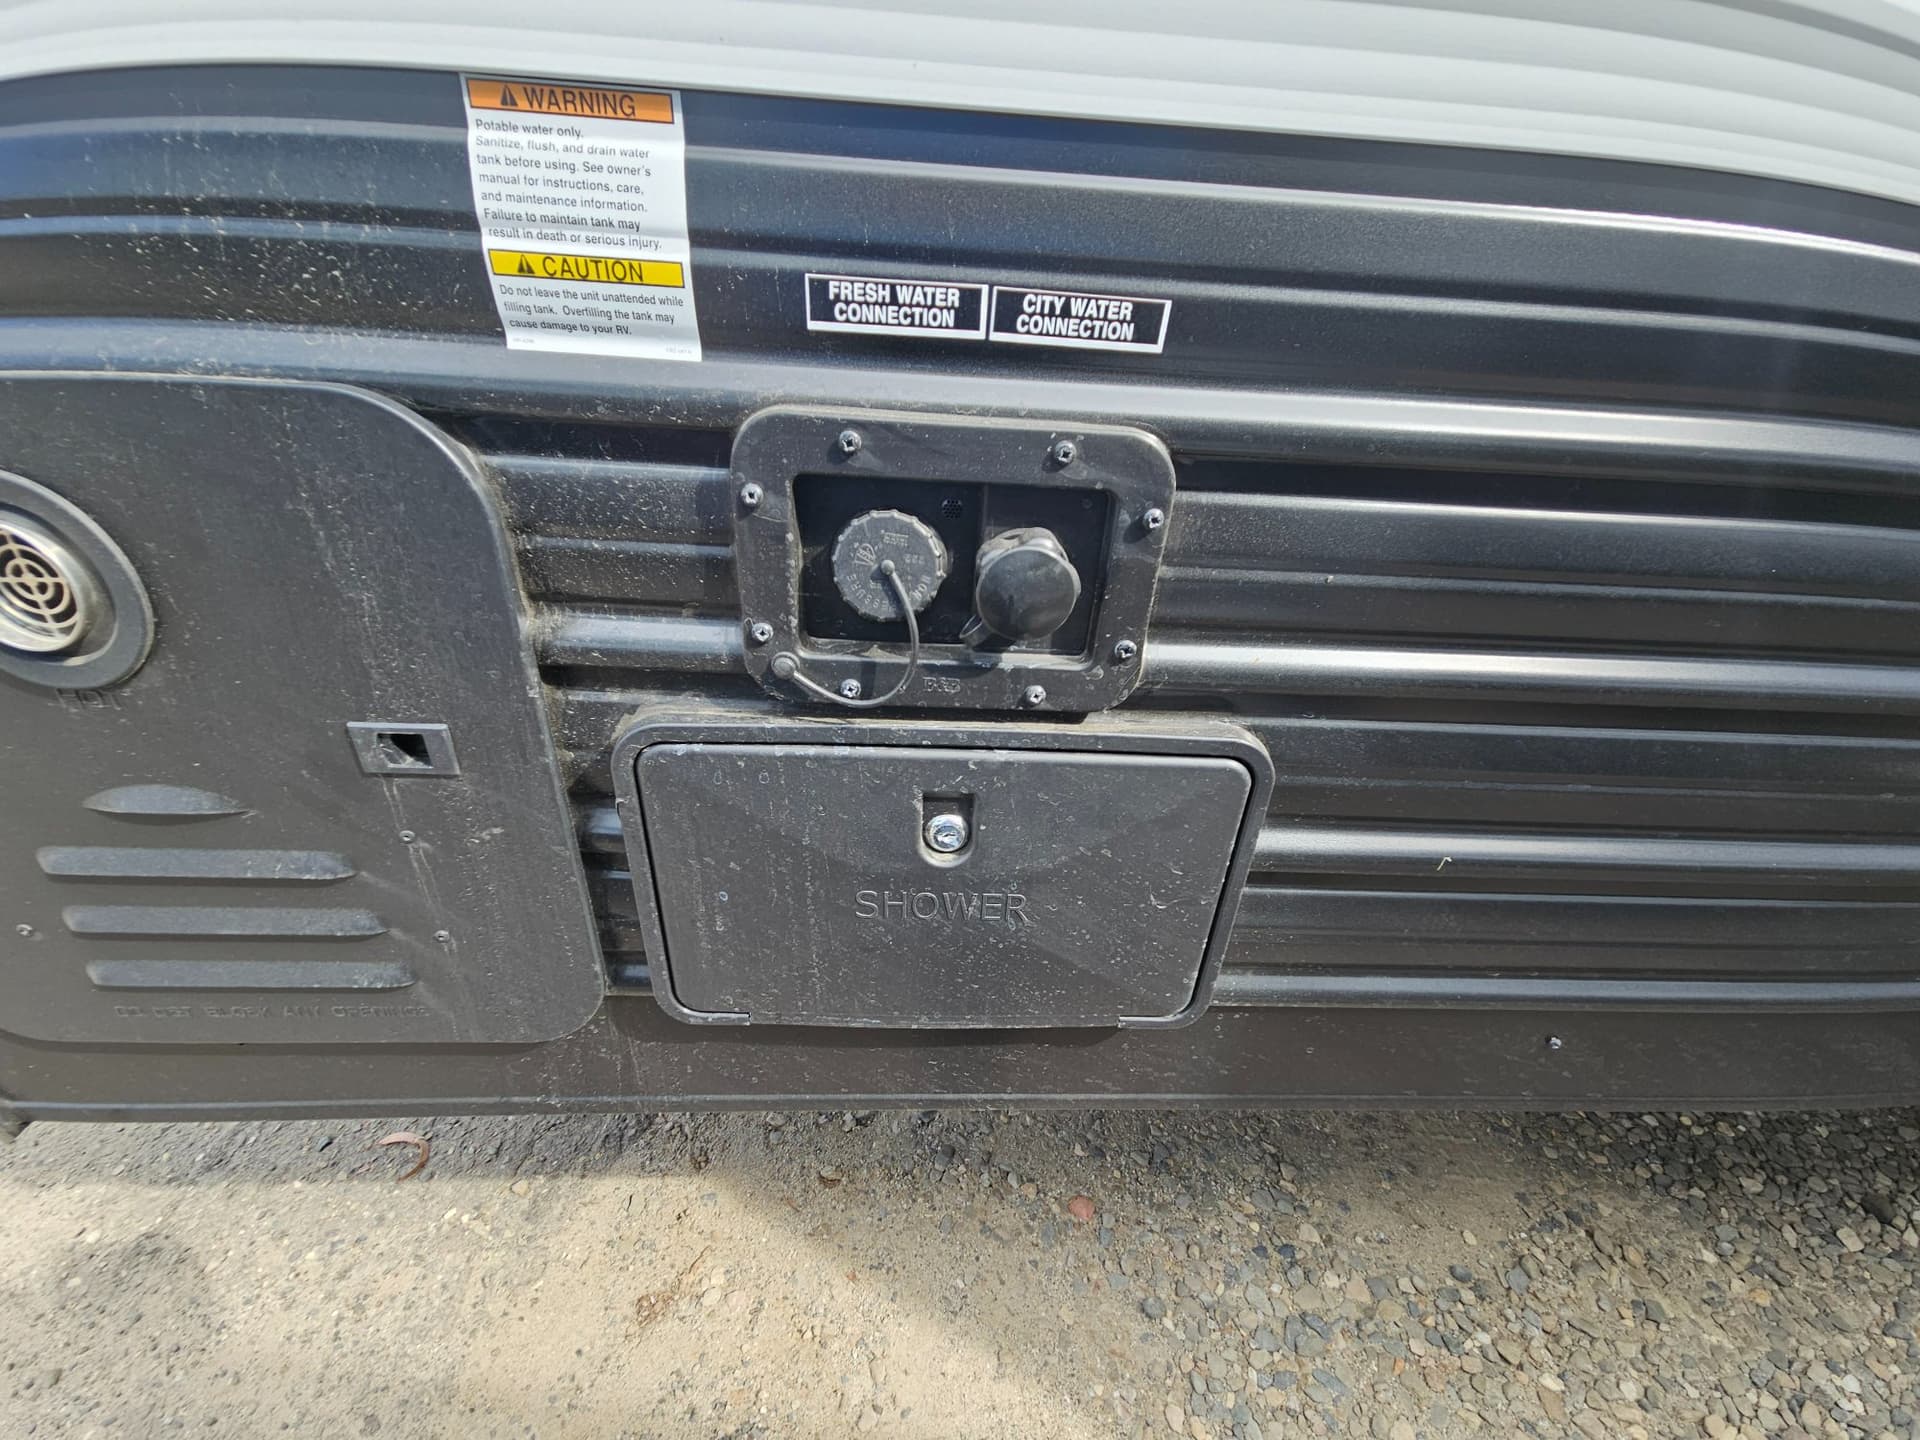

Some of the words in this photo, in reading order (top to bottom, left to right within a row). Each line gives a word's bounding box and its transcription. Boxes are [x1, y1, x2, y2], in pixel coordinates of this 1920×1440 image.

[523, 86, 636, 117] WARNING
[475, 119, 519, 133] Potable
[522, 123, 553, 135] water
[557, 126, 583, 140] only.
[475, 136, 524, 150] Sanitize,
[527, 140, 559, 153] flush,
[562, 143, 583, 154] and
[587, 144, 616, 156] drain
[620, 148, 649, 159] water
[477, 154, 501, 165] tank
[505, 156, 541, 169] before
[545, 160, 579, 173] using.
[583, 161, 603, 173] See
[607, 164, 651, 177] owner's
[479, 172, 520, 185] manual
[524, 175, 539, 186] for
[543, 176, 614, 193] instructions,
[616, 183, 644, 195] care,
[481, 191, 501, 202] and
[505, 192, 577, 206] maintenance
[580, 197, 648, 212] information.
[483, 208, 522, 221] Failure
[526, 211, 537, 222] to
[540, 213, 588, 226] maintain
[590, 217, 615, 228] tank
[618, 221, 640, 232] may
[488, 228, 520, 238] result
[523, 229, 534, 239] in
[536, 230, 566, 242] death
[570, 234, 581, 243] or
[585, 233, 625, 246] serious
[628, 235, 662, 250] injury.
[542, 256, 643, 282] CAUTION
[499, 284, 514, 295] Do
[516, 286, 533, 297] not
[535, 287, 560, 299] leave
[562, 289, 578, 300] the
[581, 290, 600, 302] unit
[602, 292, 656, 305] unattended
[658, 295, 684, 307] while
[829, 281, 890, 304] FRESH
[896, 285, 960, 308] WATER
[503, 302, 531, 315] filling
[533, 304, 557, 315] tank.
[562, 305, 612, 320] Overfilling
[614, 309, 630, 320] the
[632, 310, 652, 321] tank
[656, 313, 675, 325] may
[833, 303, 955, 328] CONNECTION
[1022, 294, 1065, 315] CITY
[1069, 297, 1133, 321] WATER
[509, 319, 538, 329] cause
[540, 319, 577, 333] damage
[580, 322, 590, 331] to
[591, 323, 613, 335] your
[616, 324, 632, 335] RV.
[1016, 314, 1134, 341] CONNECTION
[855, 890, 1029, 922] SHOWER
